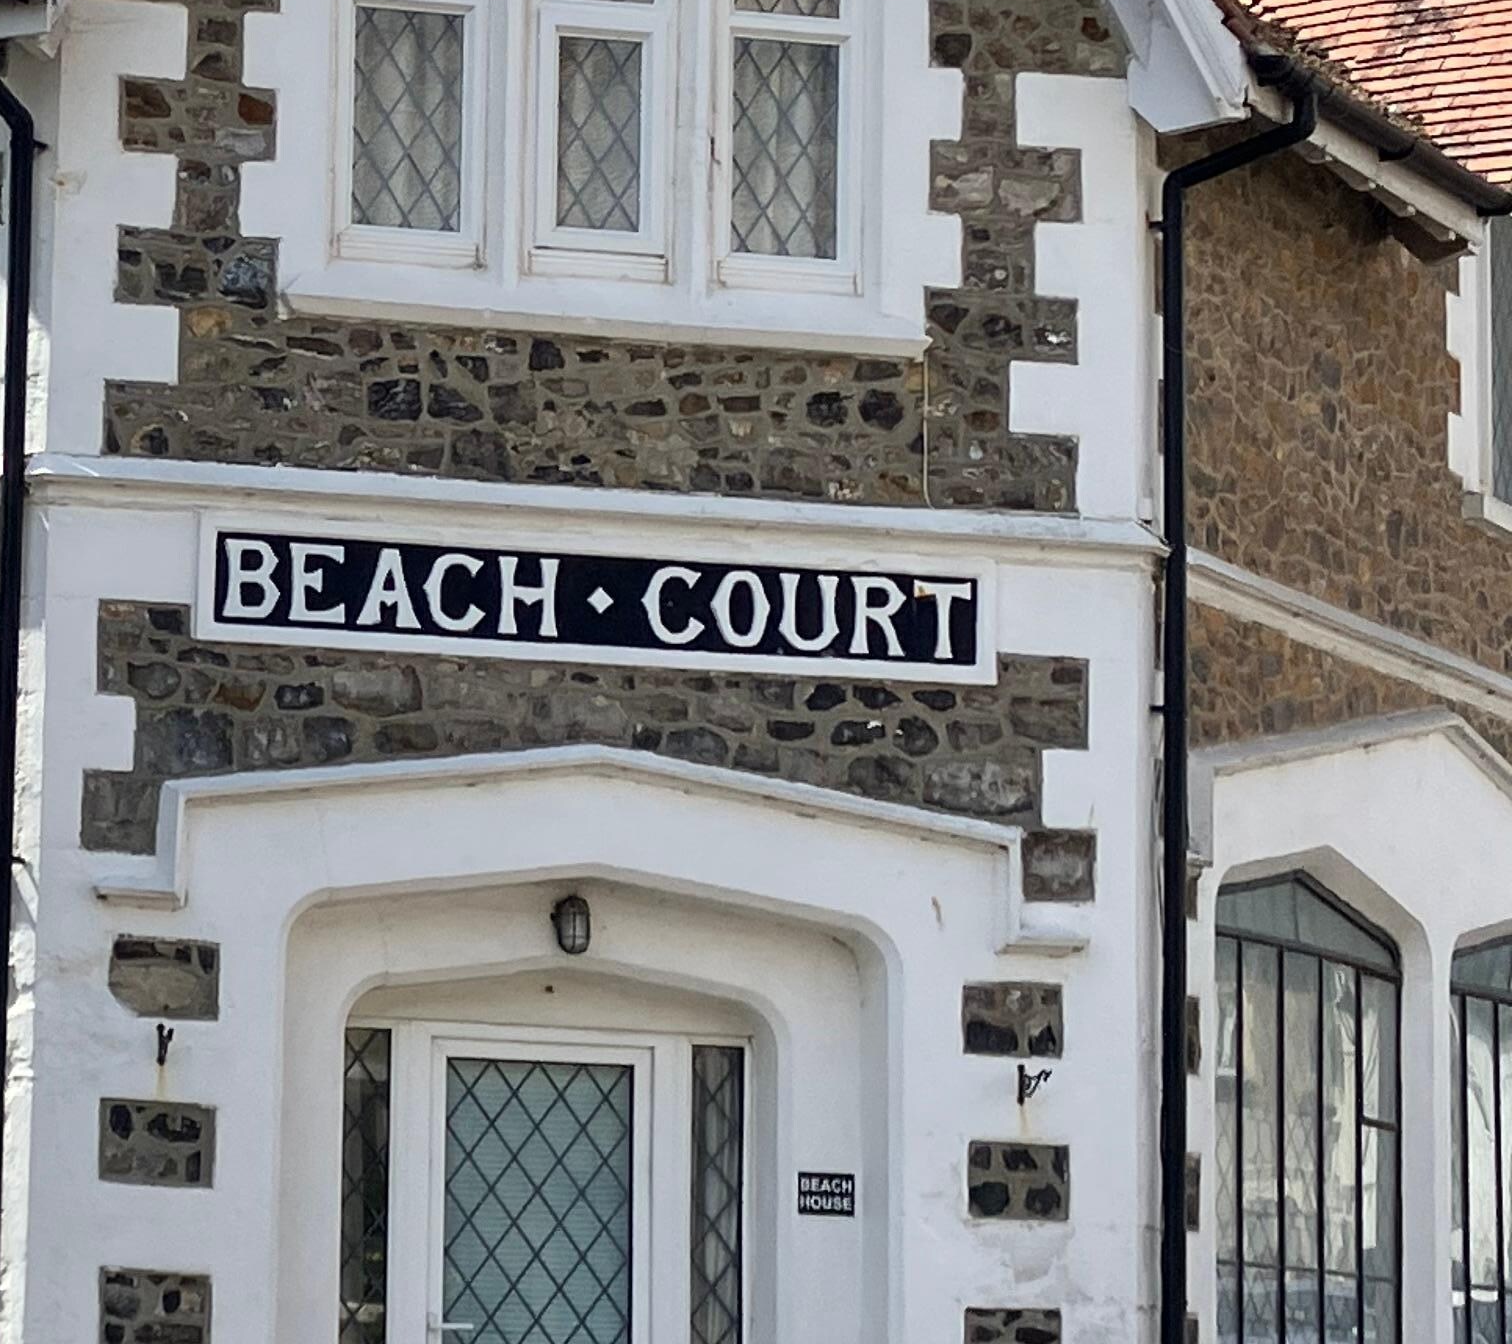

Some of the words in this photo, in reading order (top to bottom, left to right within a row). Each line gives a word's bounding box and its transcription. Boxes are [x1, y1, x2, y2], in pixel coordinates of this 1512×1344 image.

[221, 537, 560, 637] BEACH
[641, 566, 971, 659] COURT
[800, 1178, 852, 1193] BEACH
[800, 1195, 852, 1211] HOUSE
